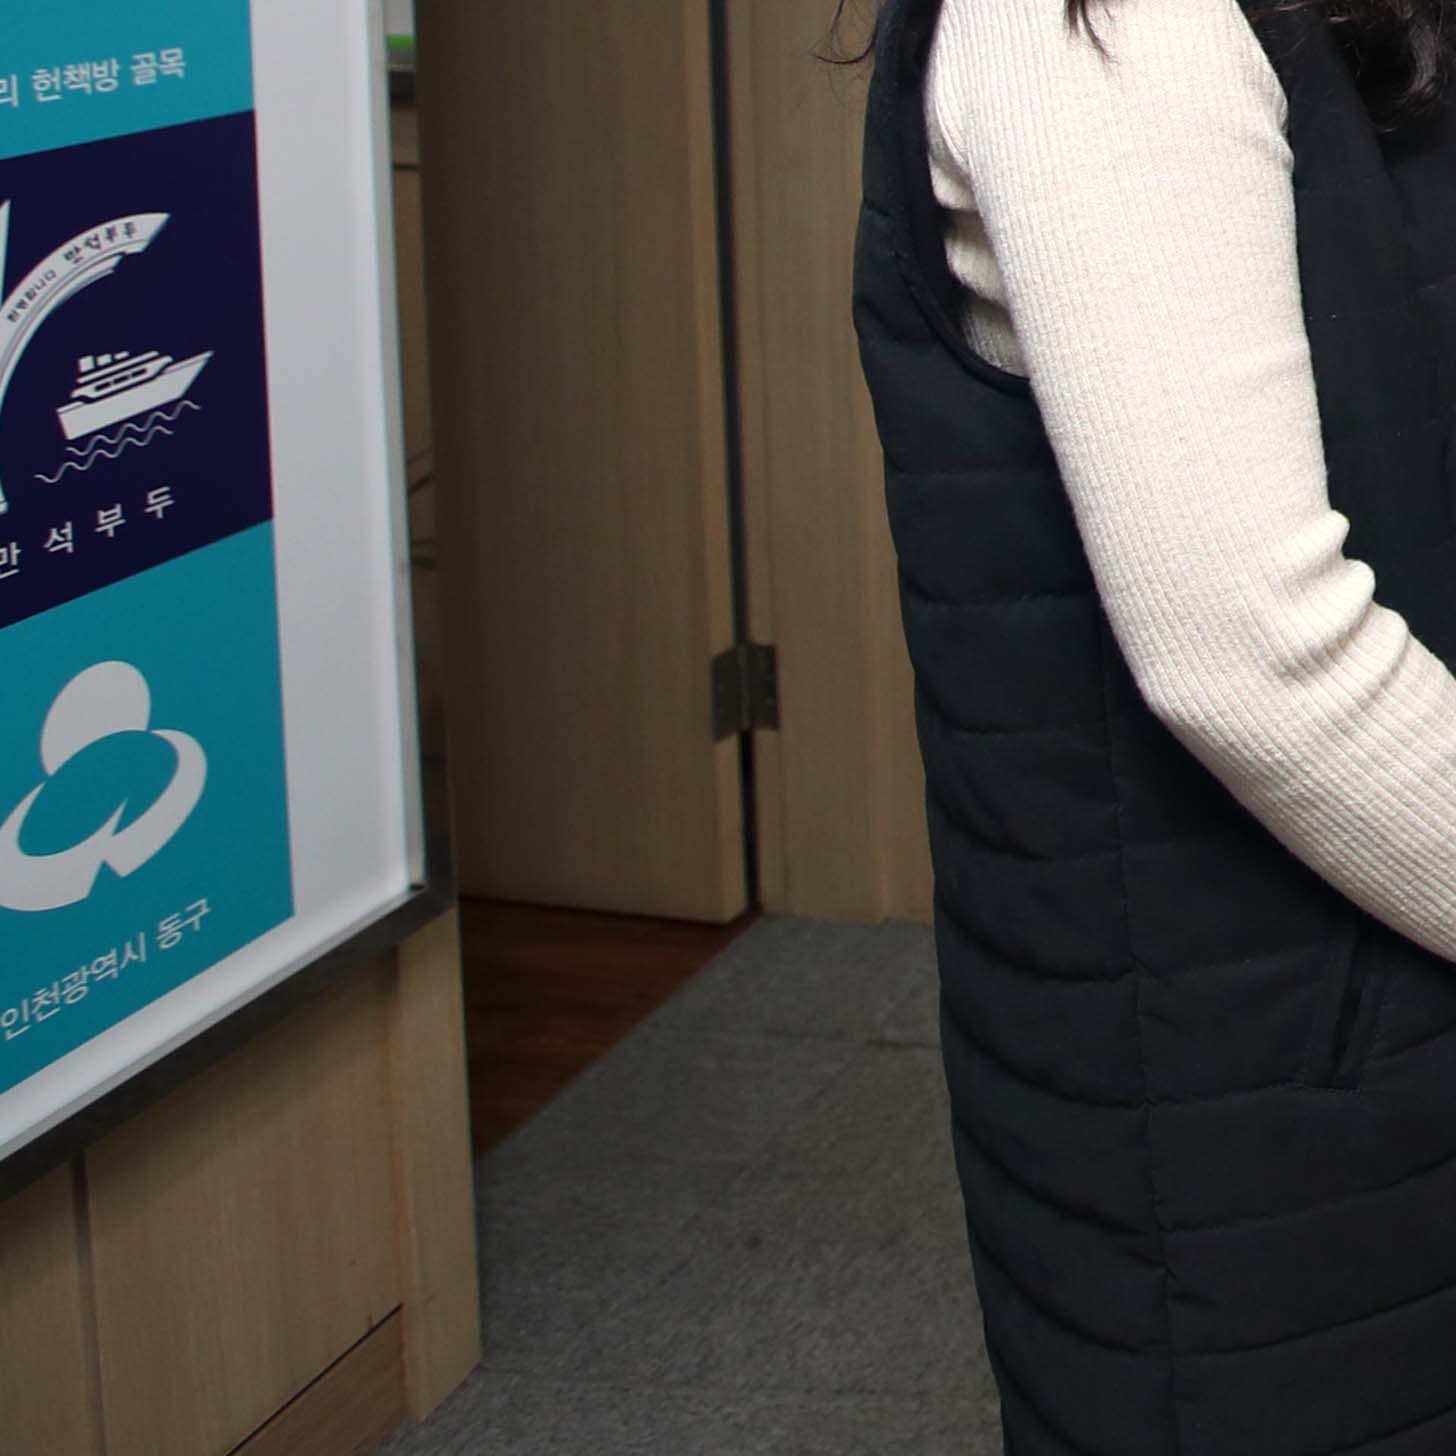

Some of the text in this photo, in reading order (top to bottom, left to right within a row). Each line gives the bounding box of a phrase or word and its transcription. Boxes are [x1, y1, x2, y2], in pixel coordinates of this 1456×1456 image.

[31, 57, 120, 103] 헌책방
[130, 47, 186, 86] 골목
[0, 897, 212, 1041] 인천광역시 동구
